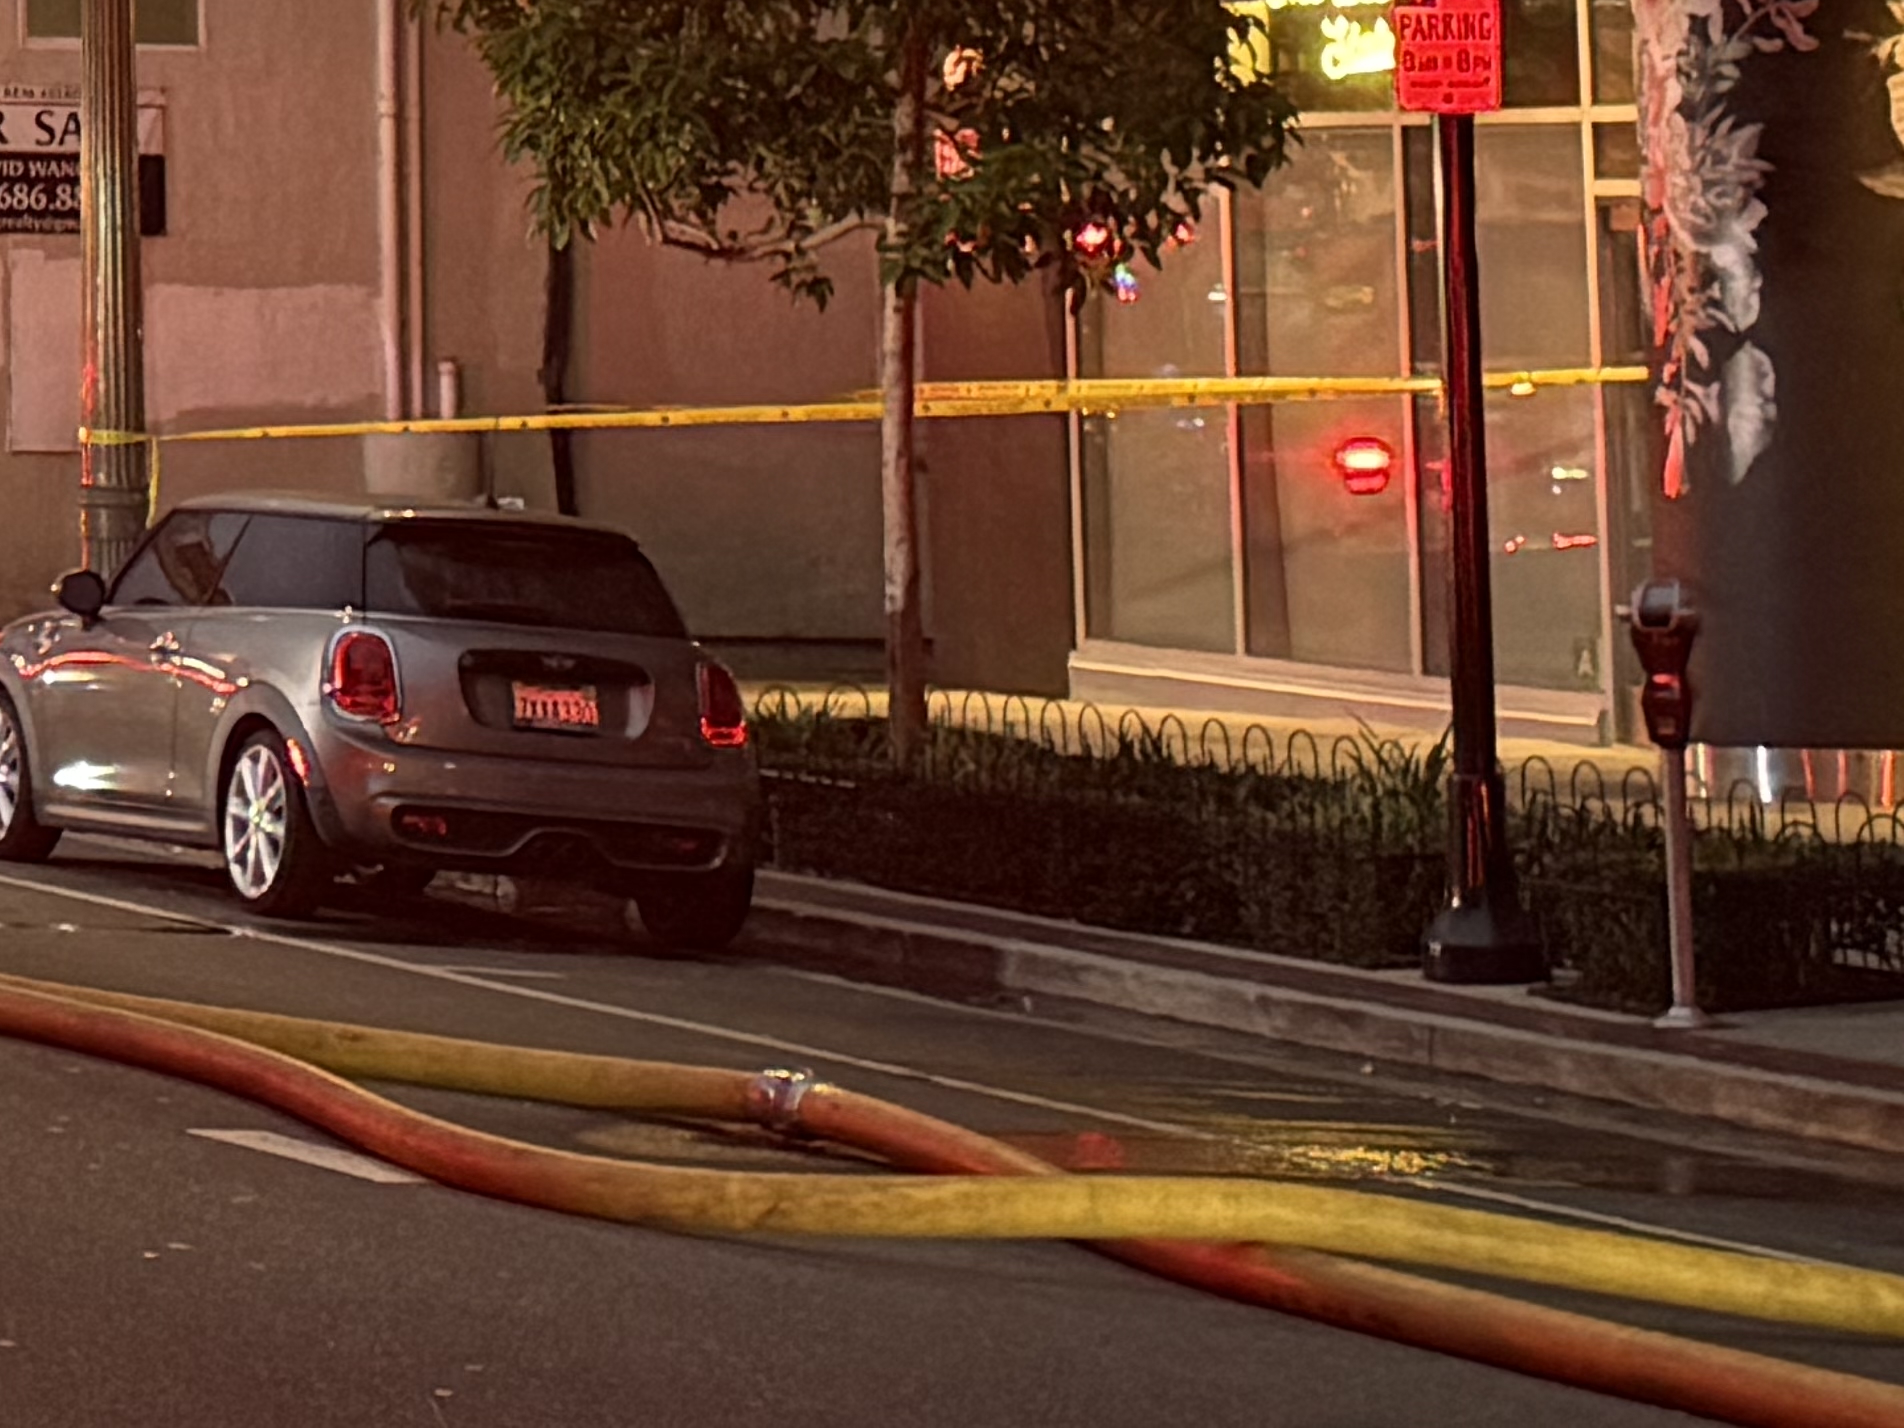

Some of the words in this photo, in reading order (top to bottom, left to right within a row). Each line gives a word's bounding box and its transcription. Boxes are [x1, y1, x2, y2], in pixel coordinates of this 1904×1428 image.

[1398, 10, 1493, 42] PARKING
[33, 109, 82, 147] SA
[29, 159, 81, 179] WAN
